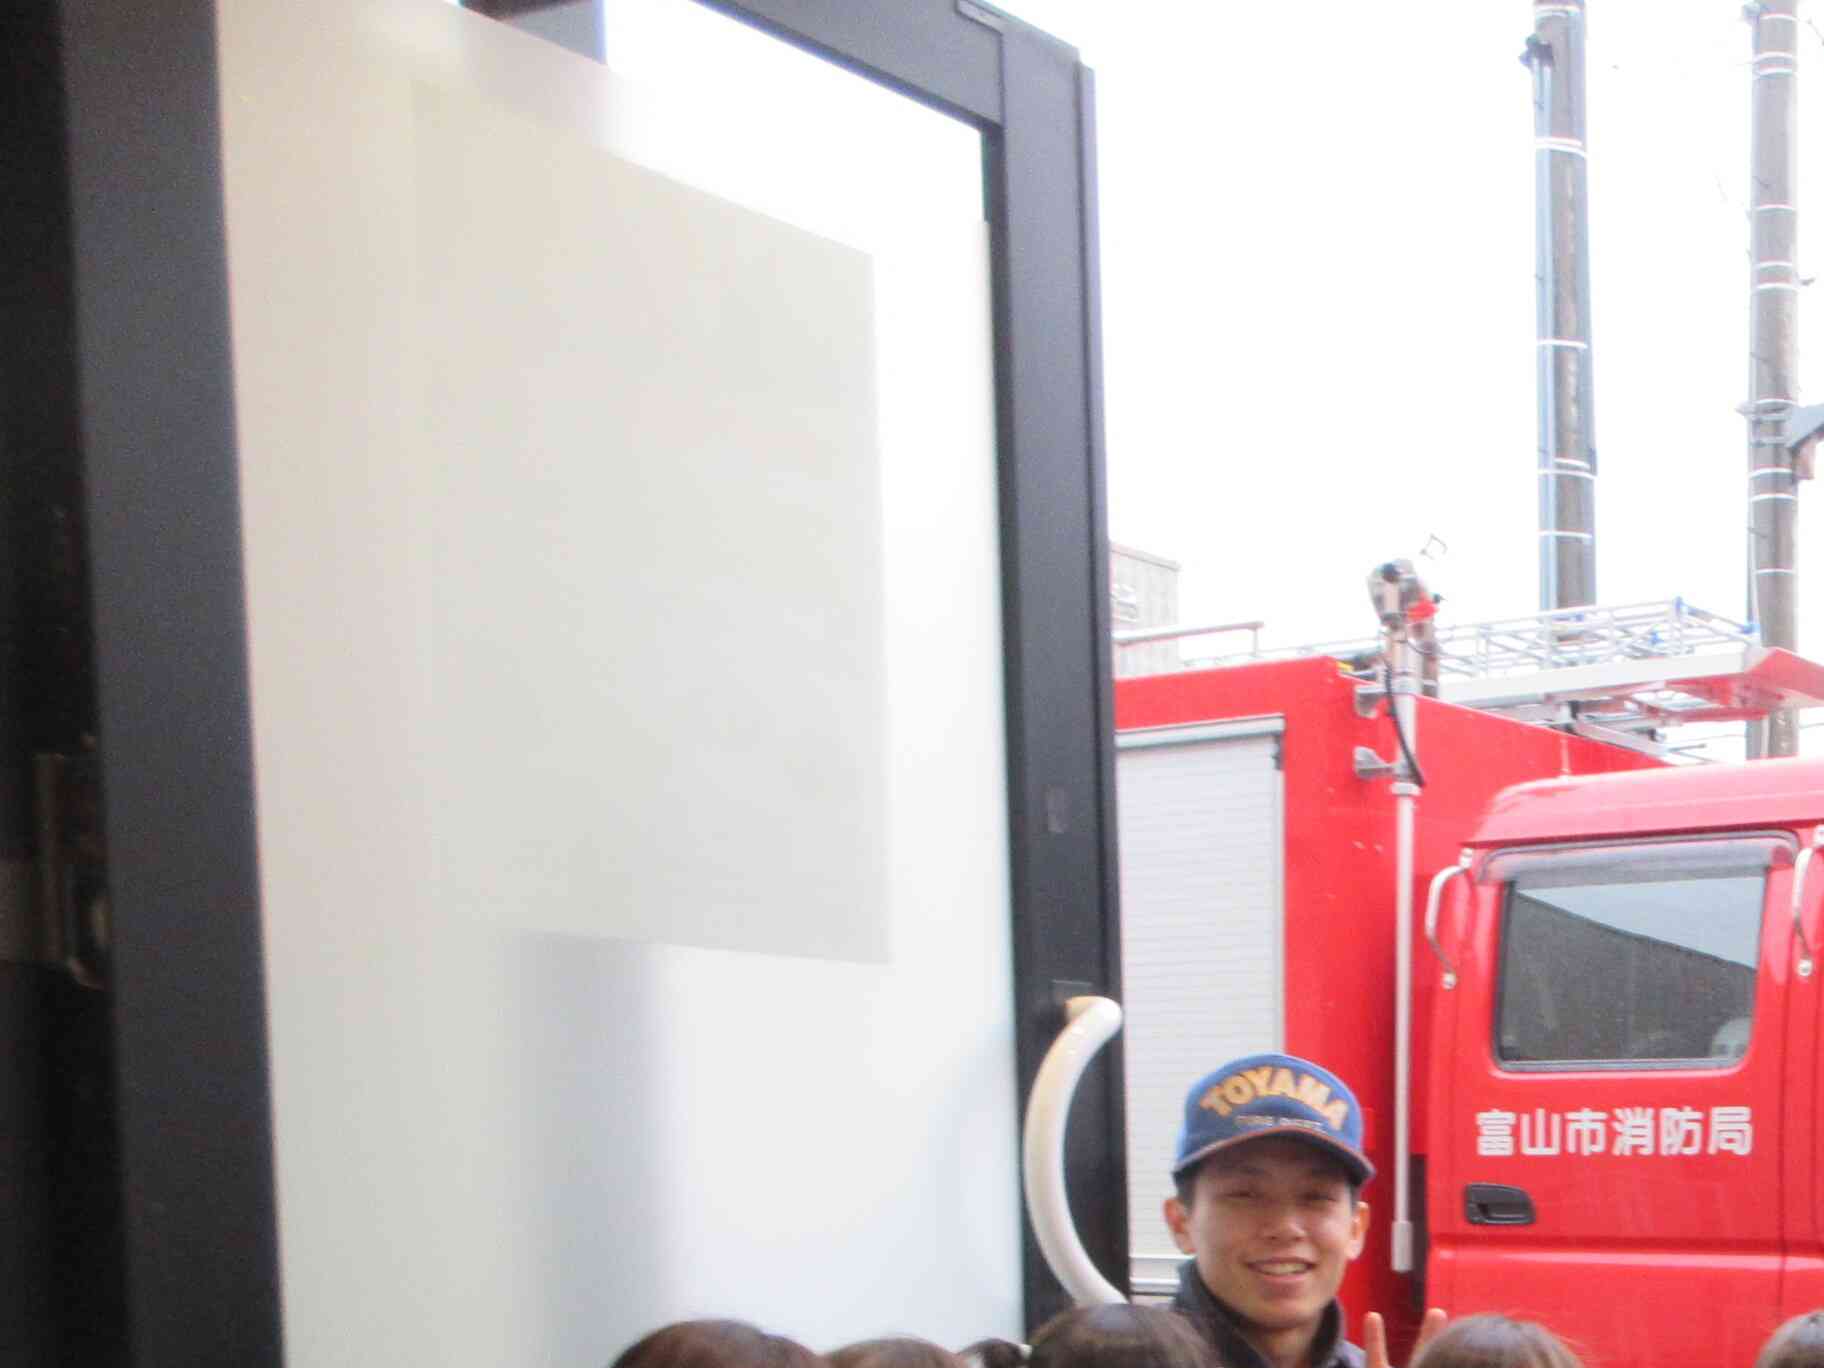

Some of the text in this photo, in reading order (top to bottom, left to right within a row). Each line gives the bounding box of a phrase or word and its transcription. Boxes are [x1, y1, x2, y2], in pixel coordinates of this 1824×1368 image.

[1200, 1065, 1349, 1131] TOYAMA
[1474, 1105, 1754, 1157] 富山市消防局
